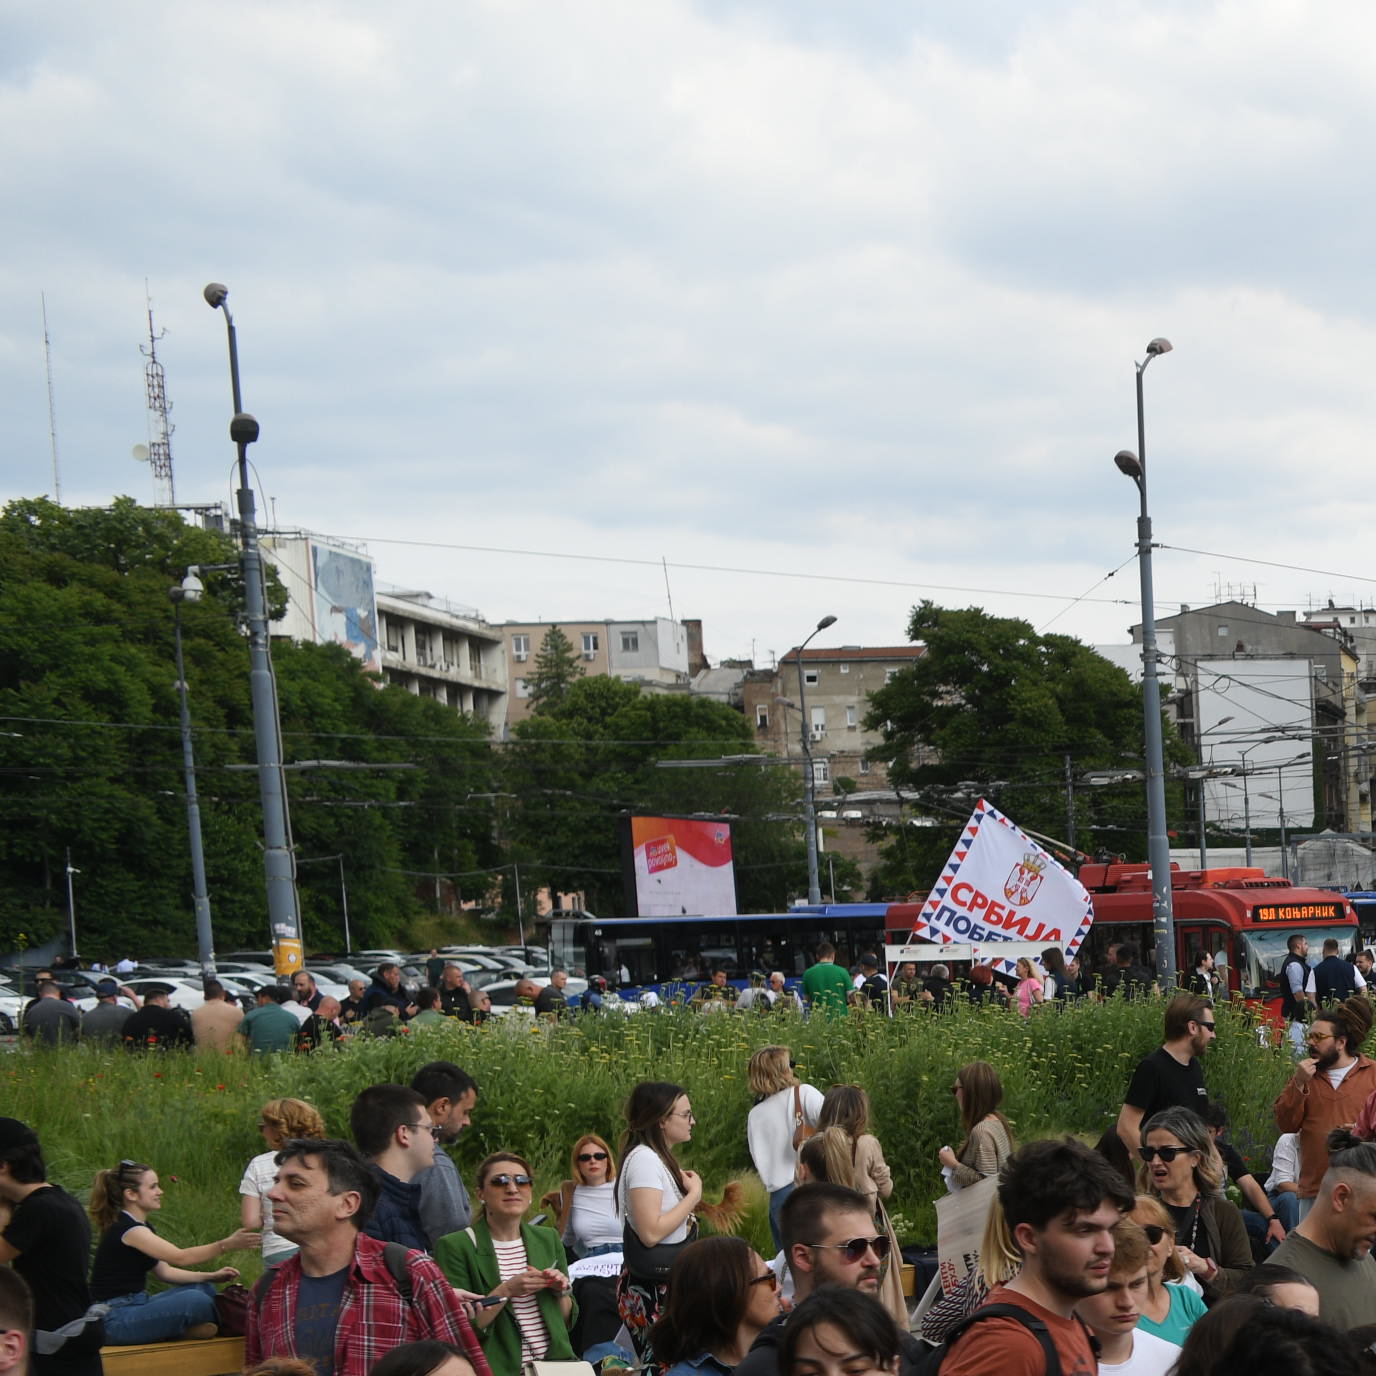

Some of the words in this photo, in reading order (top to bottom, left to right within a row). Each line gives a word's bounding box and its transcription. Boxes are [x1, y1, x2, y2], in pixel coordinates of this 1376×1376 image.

[951, 881, 1062, 942] СРБИЈА
[1259, 907, 1276, 920] 19Л
[1279, 905, 1335, 919] КОЊАРНИК
